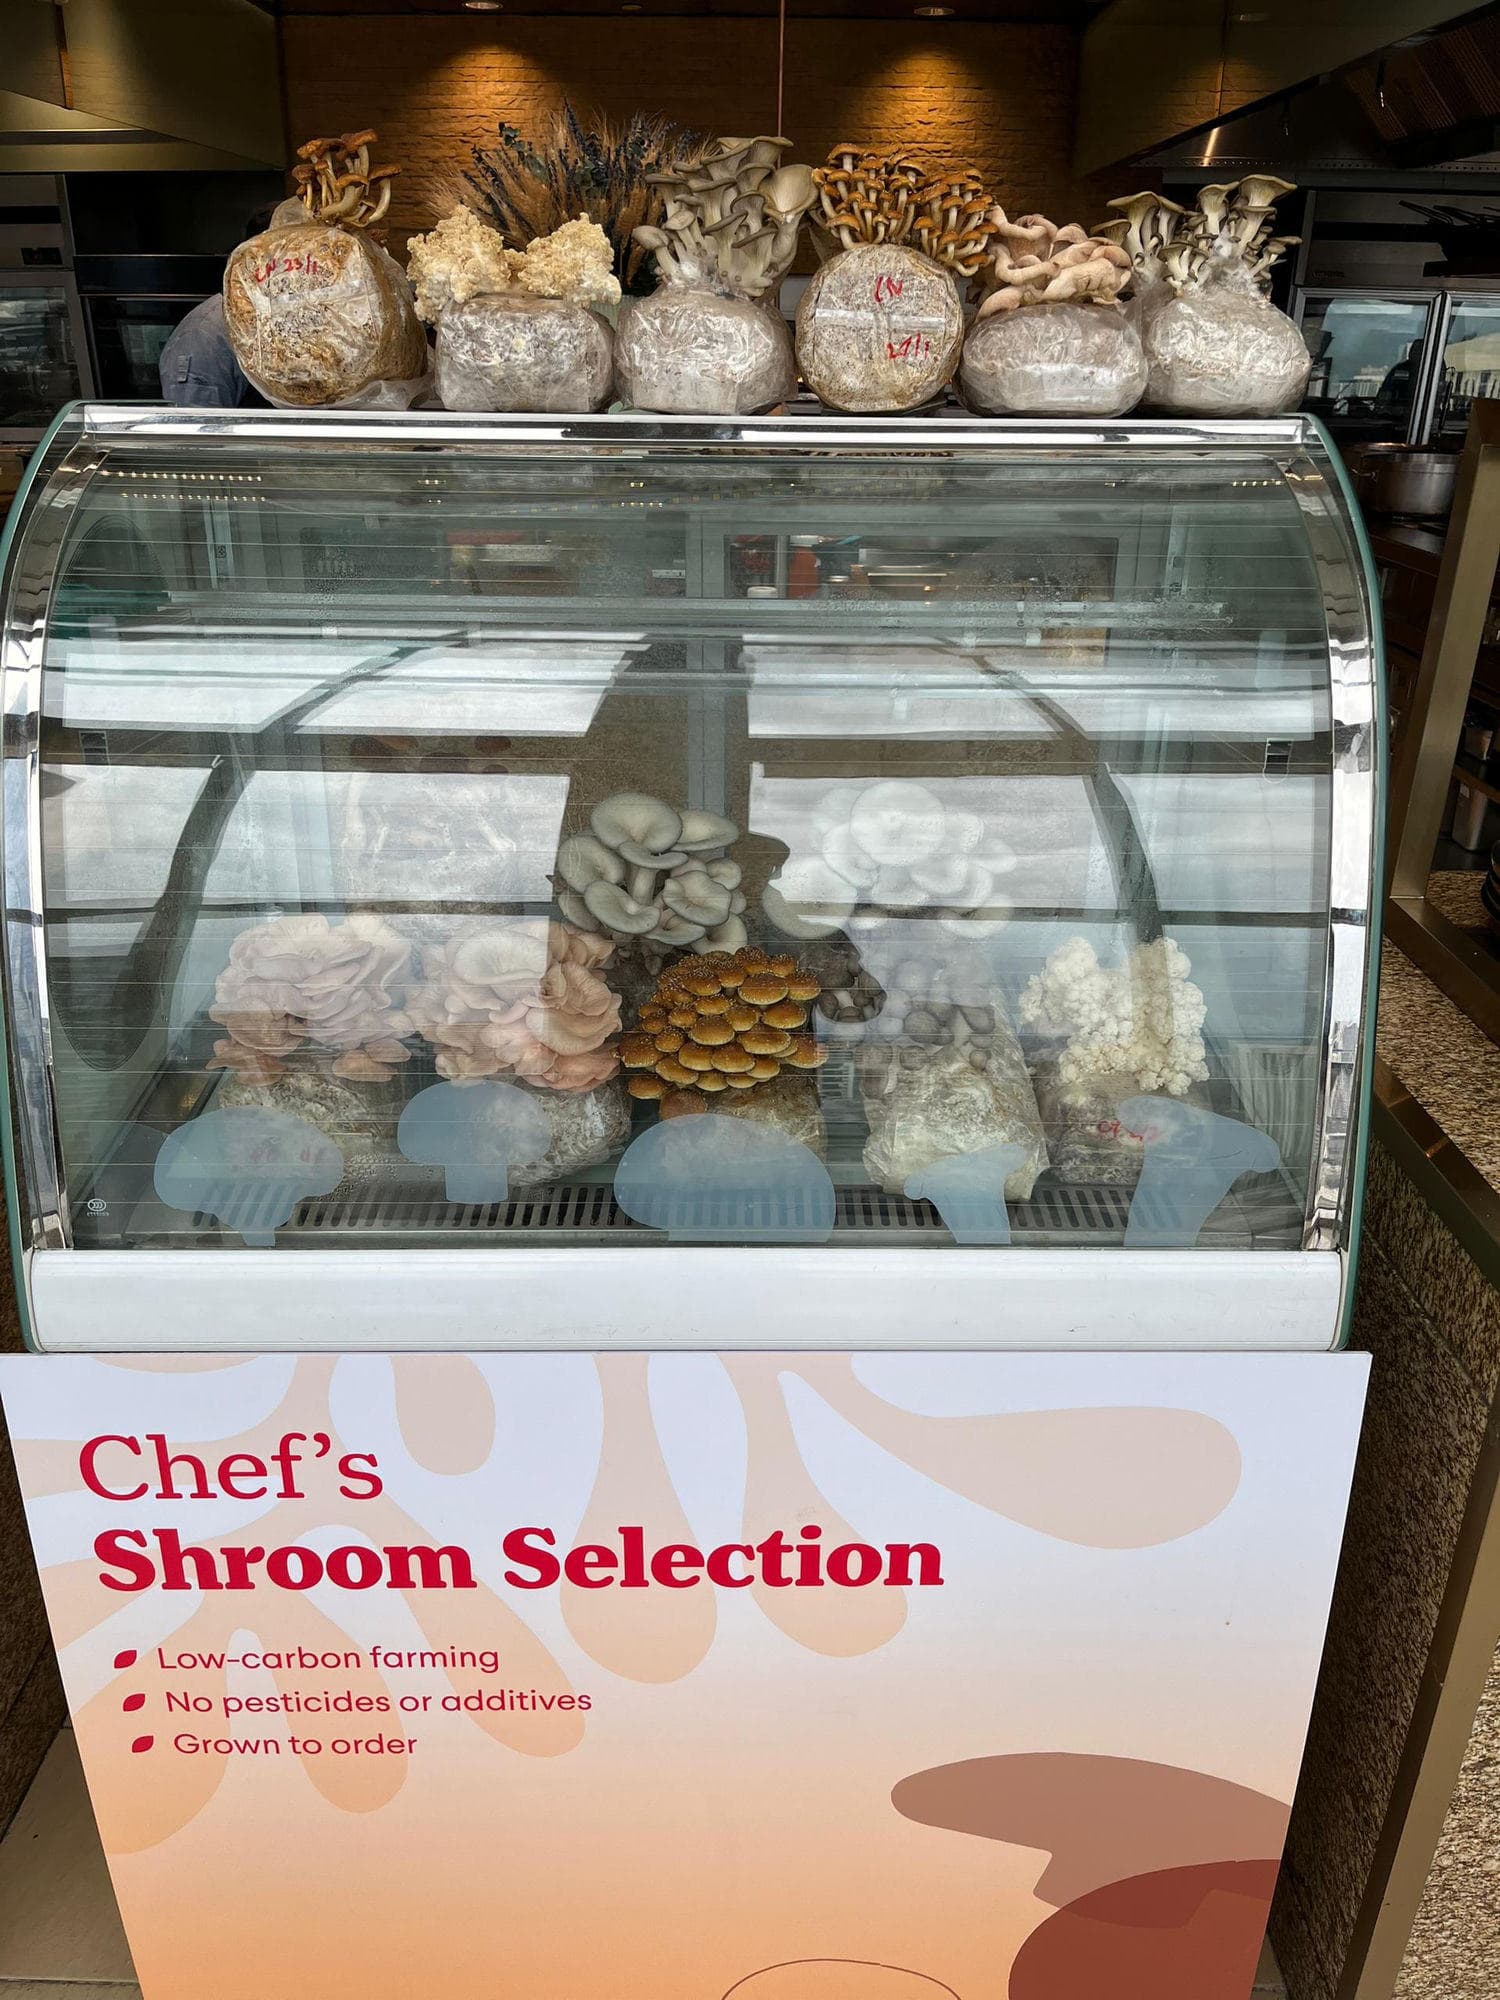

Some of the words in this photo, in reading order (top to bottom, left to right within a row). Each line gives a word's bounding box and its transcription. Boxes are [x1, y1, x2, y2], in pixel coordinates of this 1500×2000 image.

[78, 1432, 383, 1501] Chef’s
[93, 1527, 478, 1592] Shroom
[502, 1524, 945, 1591] Selection
[157, 1647, 362, 1669] Low-carbon
[369, 1646, 500, 1675] farming
[165, 1691, 213, 1713] No
[222, 1688, 391, 1719] pesticides
[398, 1695, 431, 1712] or
[441, 1688, 593, 1712] additives
[173, 1733, 281, 1756] Grown
[287, 1736, 323, 1756] to
[329, 1732, 417, 1756] order
